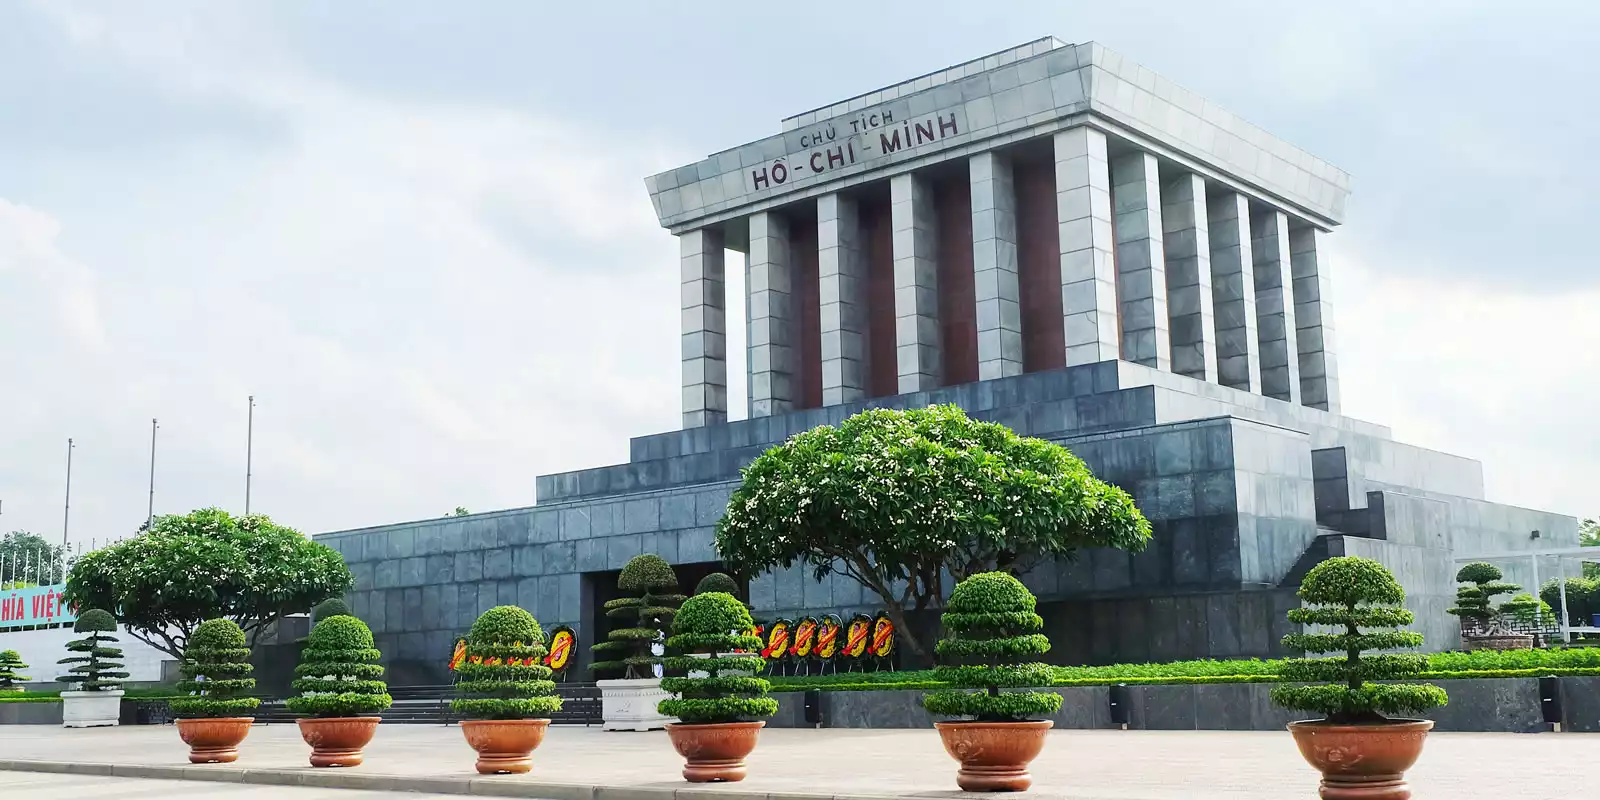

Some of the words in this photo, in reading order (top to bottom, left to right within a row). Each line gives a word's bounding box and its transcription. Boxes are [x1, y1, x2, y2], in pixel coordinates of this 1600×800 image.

[800, 122, 836, 148] CHỦ
[850, 110, 893, 136] TỊCH
[752, 157, 788, 191] HỒ
[810, 136, 855, 173] CHÍ
[32, 588, 63, 622] VIỆT
